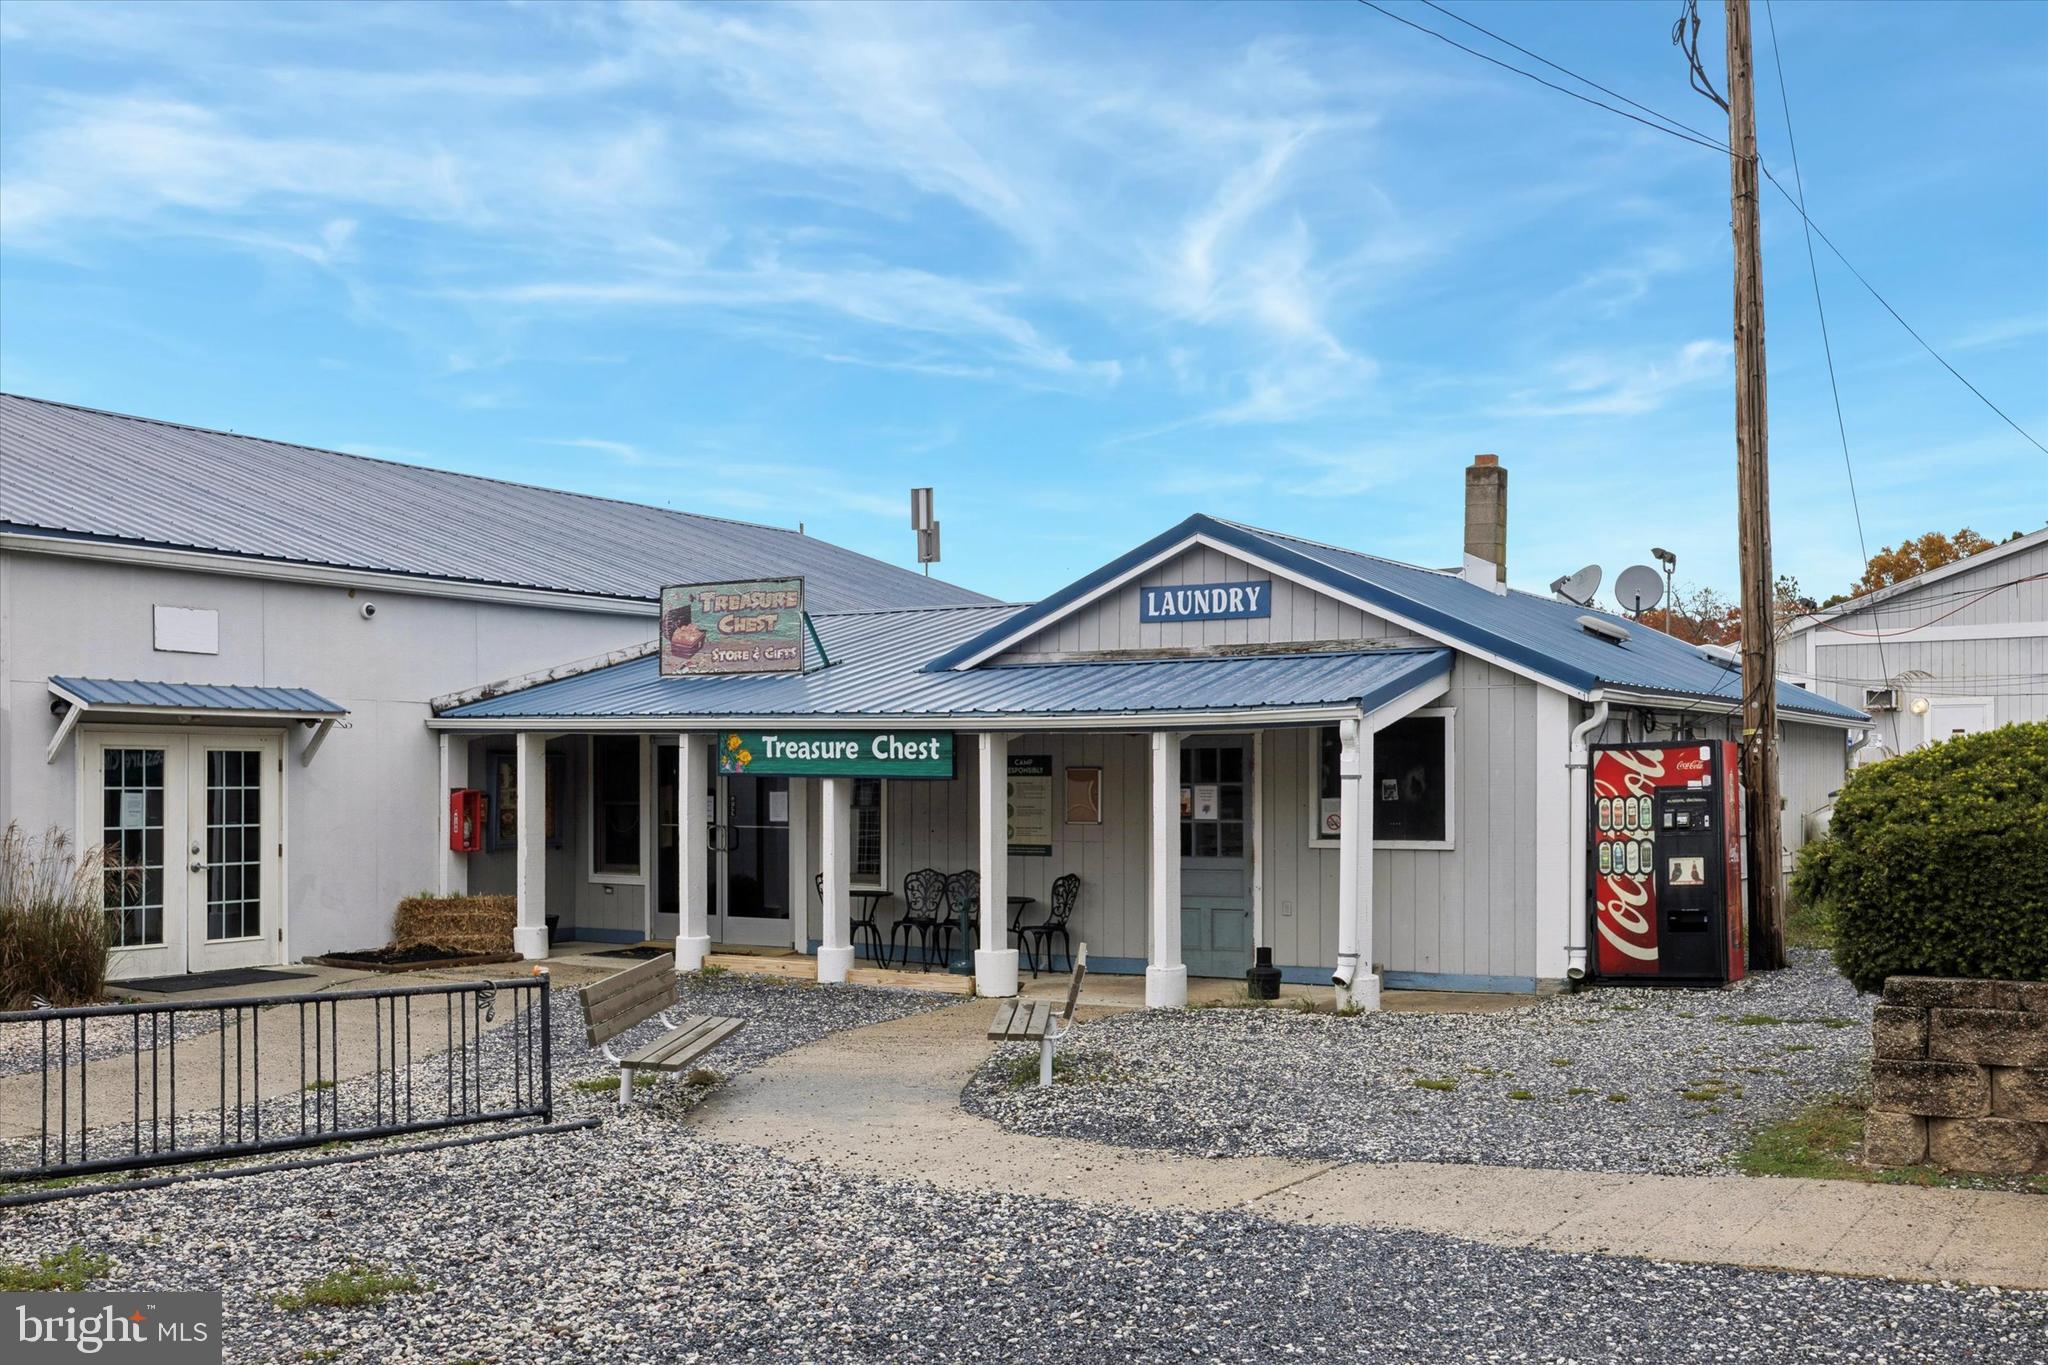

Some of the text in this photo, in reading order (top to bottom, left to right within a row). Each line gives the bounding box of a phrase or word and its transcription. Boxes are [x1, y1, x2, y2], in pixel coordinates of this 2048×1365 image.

[699, 590, 798, 613] TREASURE
[1148, 586, 1261, 616] LAUNDRY
[717, 614, 778, 635] CHEST
[711, 647, 749, 663] STORE
[762, 734, 940, 760] Treasure Chest
[1676, 760, 1705, 770] Coca-Cola
